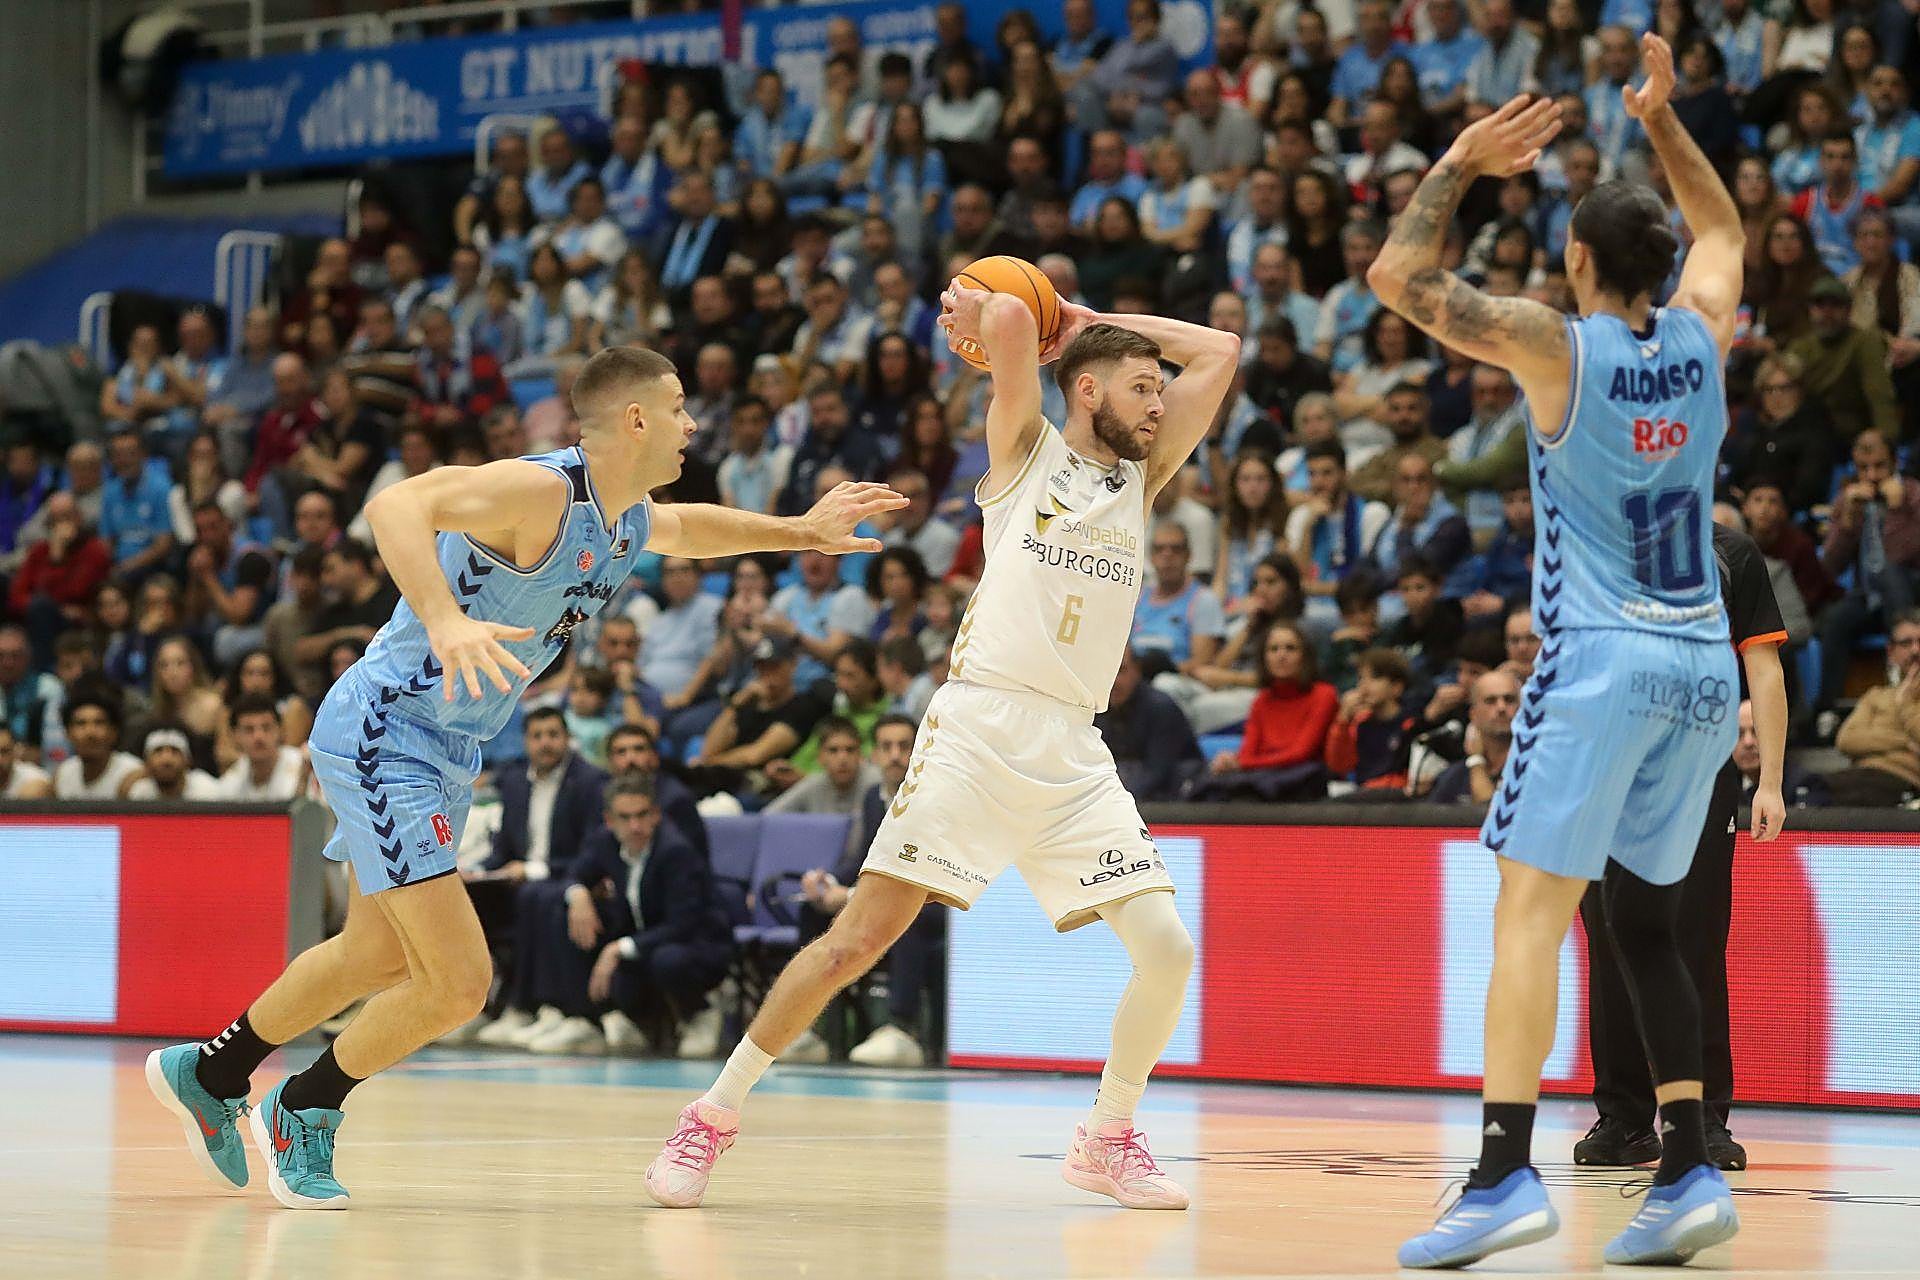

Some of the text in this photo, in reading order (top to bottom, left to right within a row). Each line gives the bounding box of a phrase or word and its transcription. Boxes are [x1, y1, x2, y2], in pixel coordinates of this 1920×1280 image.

[1608, 358, 1704, 404] ALONSO
[1634, 418, 1689, 453] Río
[1620, 486, 1705, 591] 10
[1056, 594, 1085, 646] 6
[927, 854, 961, 872] CASTILLA
[1080, 860, 1151, 887] LEXUS
